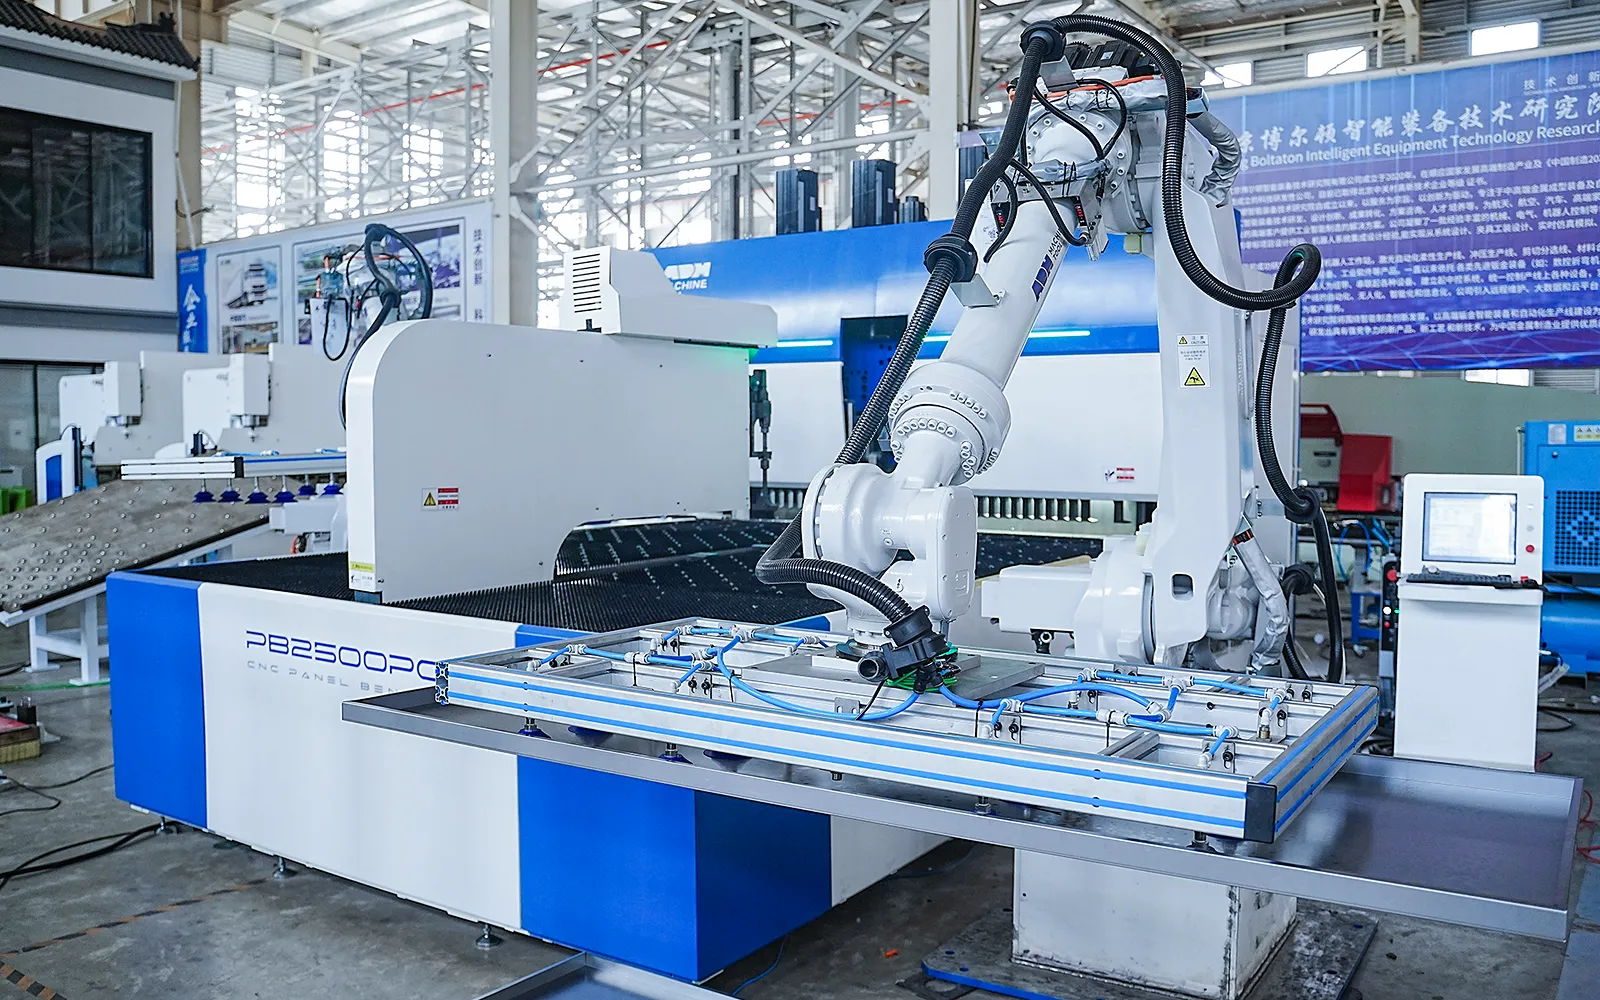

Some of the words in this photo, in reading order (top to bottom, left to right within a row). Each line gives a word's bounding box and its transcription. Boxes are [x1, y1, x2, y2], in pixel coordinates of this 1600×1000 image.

[1523, 71, 1600, 90] 技术创新
[1250, 152, 1303, 168] Boltaton
[1306, 144, 1371, 161] Intelligent
[1374, 137, 1447, 157] Equipment
[1450, 129, 1533, 147] Technology
[1537, 119, 1600, 139] Research
[1048, 229, 1061, 255] MACHI
[672, 279, 708, 291] CHINE
[247, 660, 278, 673] CNC
[289, 668, 348, 687] PANEL
